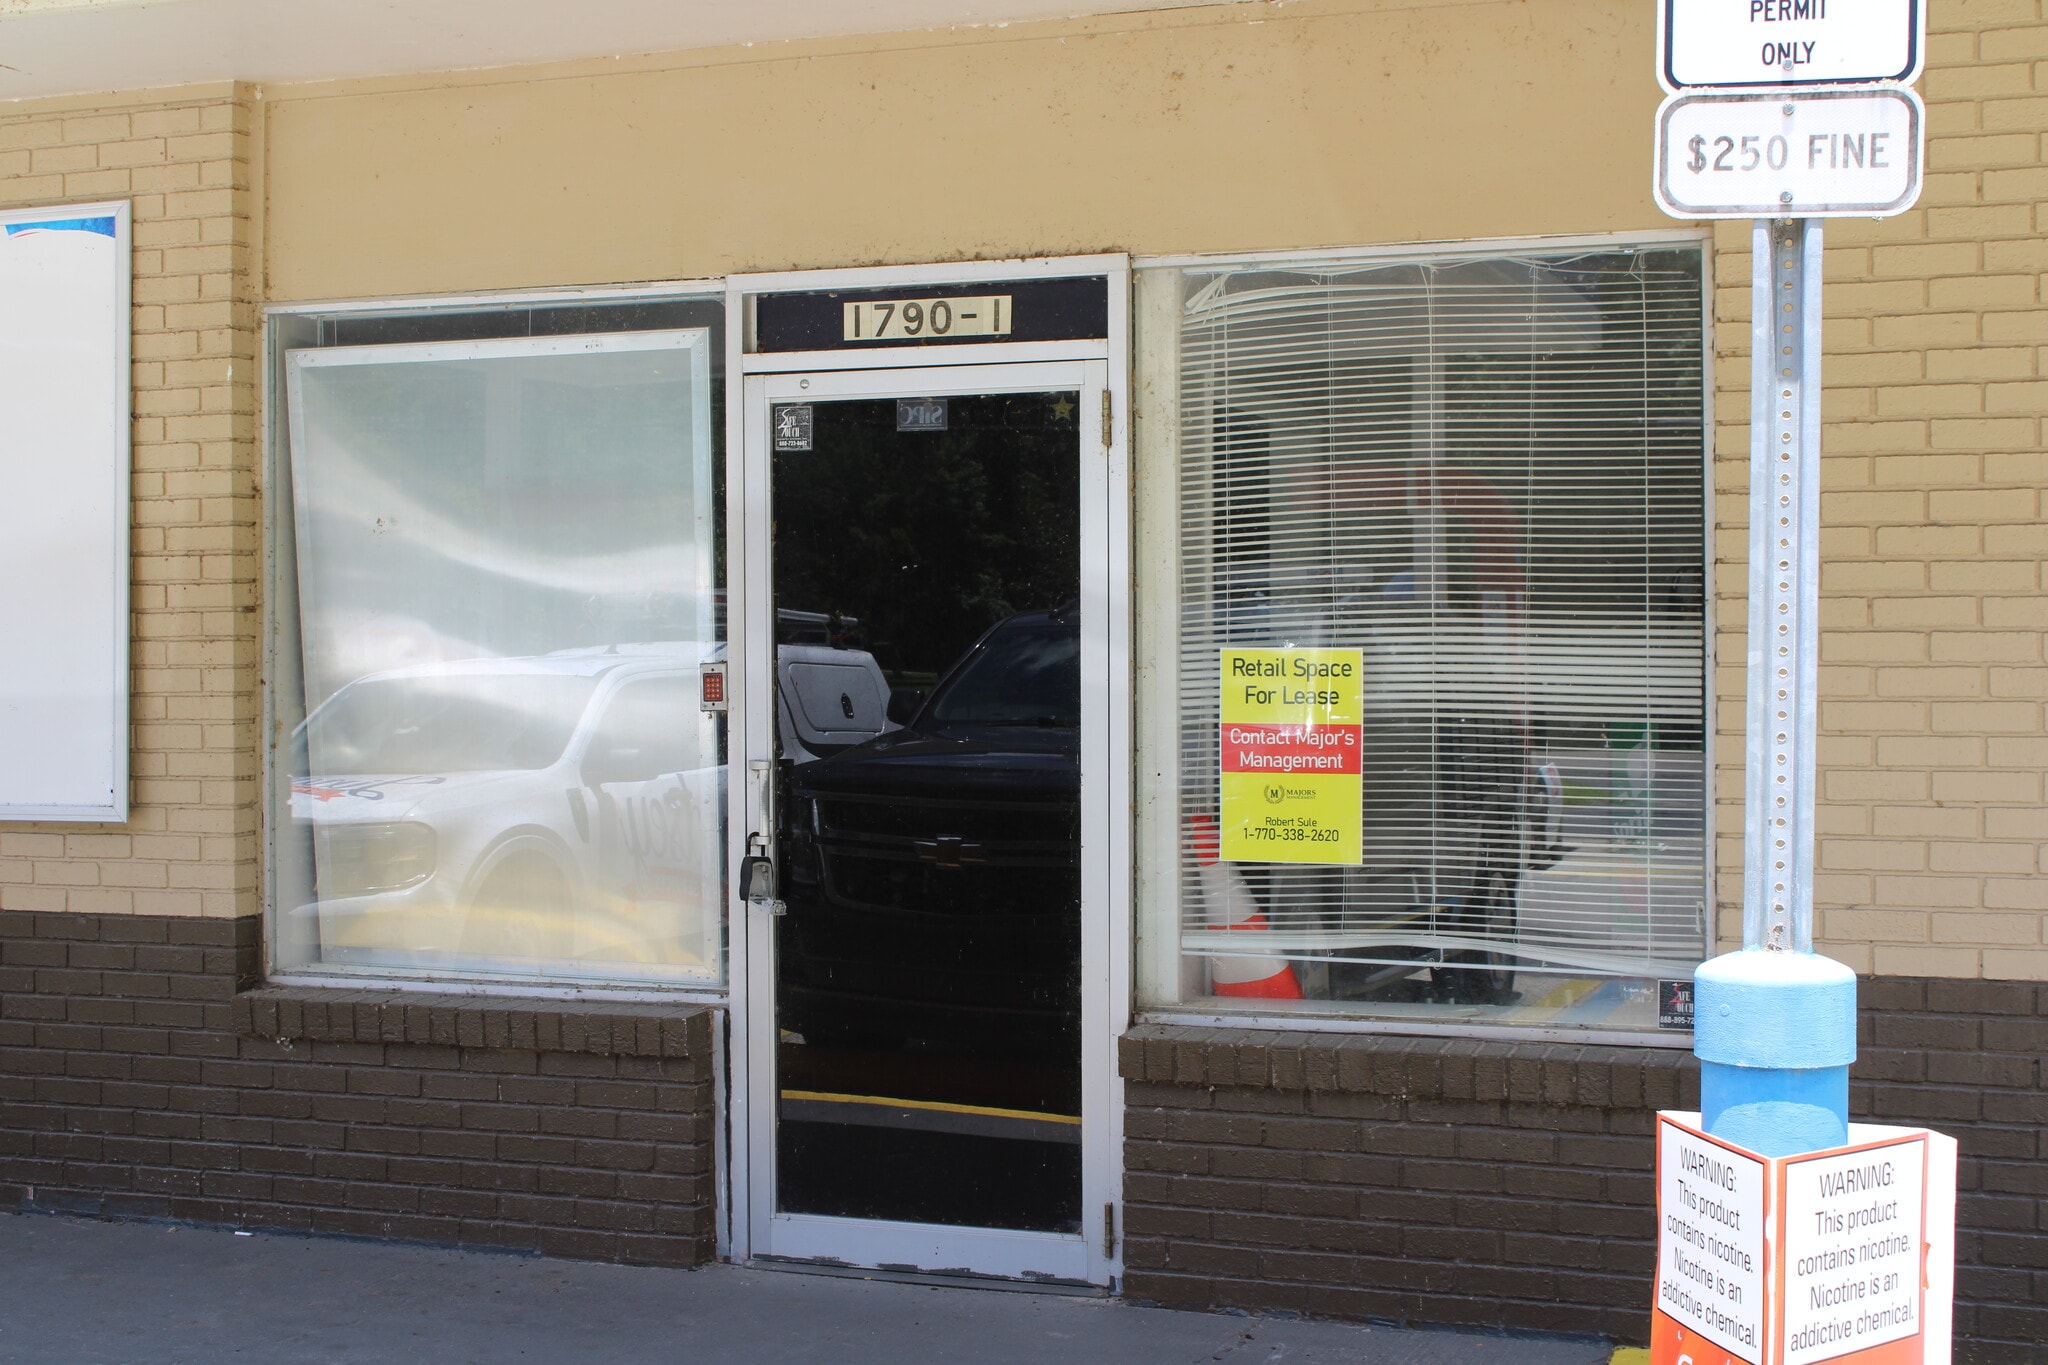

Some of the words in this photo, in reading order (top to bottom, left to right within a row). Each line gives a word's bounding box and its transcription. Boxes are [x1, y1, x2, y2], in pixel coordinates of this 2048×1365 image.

[1749, 0, 1826, 23] PERMIT
[1761, 41, 1816, 66] ONLY
[1687, 134, 1789, 174] $250
[1808, 132, 1890, 169] FINE
[853, 298, 1000, 338] 1790-1
[1232, 657, 1287, 677] Retail
[1293, 658, 1353, 682] Space
[1245, 685, 1276, 705] For
[1283, 686, 1340, 705] Lease
[1230, 728, 1291, 745] Contact
[1296, 729, 1355, 750] Major's
[1239, 751, 1343, 772] Management
[1243, 828, 1340, 842] 1-770-338-2620
[1265, 817, 1295, 827] Robert
[1297, 818, 1318, 827] Sule
[1680, 1145, 1737, 1193] WARNING:
[1819, 1161, 1896, 1199] WARNING:
[1678, 1178, 1697, 1210] This
[1699, 1193, 1740, 1232] product
[1815, 1209, 1844, 1236] This
[1847, 1199, 1898, 1235] product
[1667, 1213, 1705, 1250] contains
[1707, 1229, 1754, 1274] nicotine.
[1797, 1244, 1855, 1277] contains
[1858, 1233, 1911, 1264] nicotine.
[1674, 1246, 1714, 1290] Nicotine
[1716, 1274, 1725, 1295] is
[1728, 1284, 1742, 1305] an
[1810, 1280, 1866, 1311] Nicotine
[1869, 1274, 1881, 1299] is
[1883, 1271, 1899, 1293] an
[1662, 1279, 1703, 1320] addictive
[1705, 1304, 1758, 1349] chemical.
[1790, 1316, 1852, 1352] addictive
[1856, 1297, 1914, 1335] chemical.
